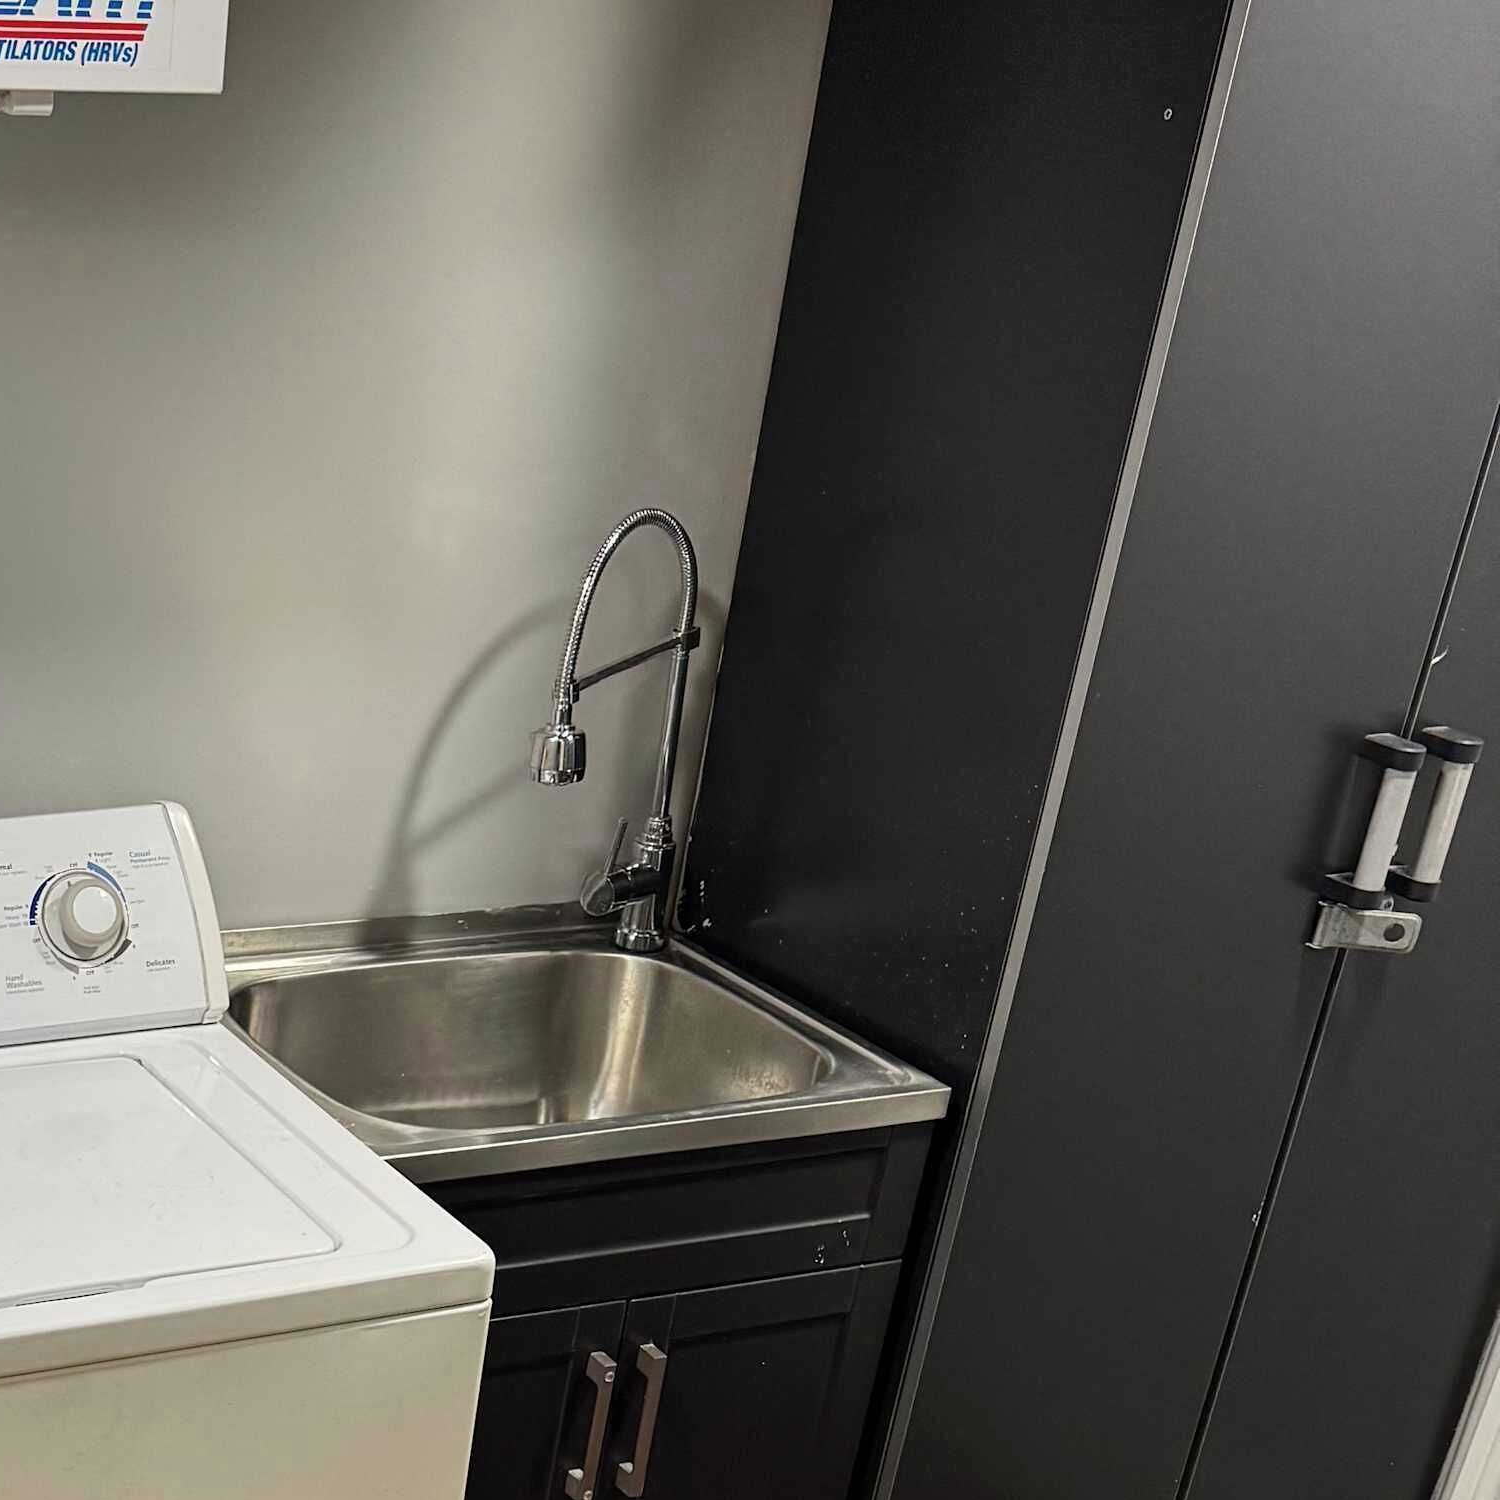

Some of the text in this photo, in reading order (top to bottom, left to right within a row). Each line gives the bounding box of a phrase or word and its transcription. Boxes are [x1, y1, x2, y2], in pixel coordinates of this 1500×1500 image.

[81, 40, 139, 67] (HRVs)
[129, 850, 151, 858] Casual
[146, 959, 176, 967] Delicates
